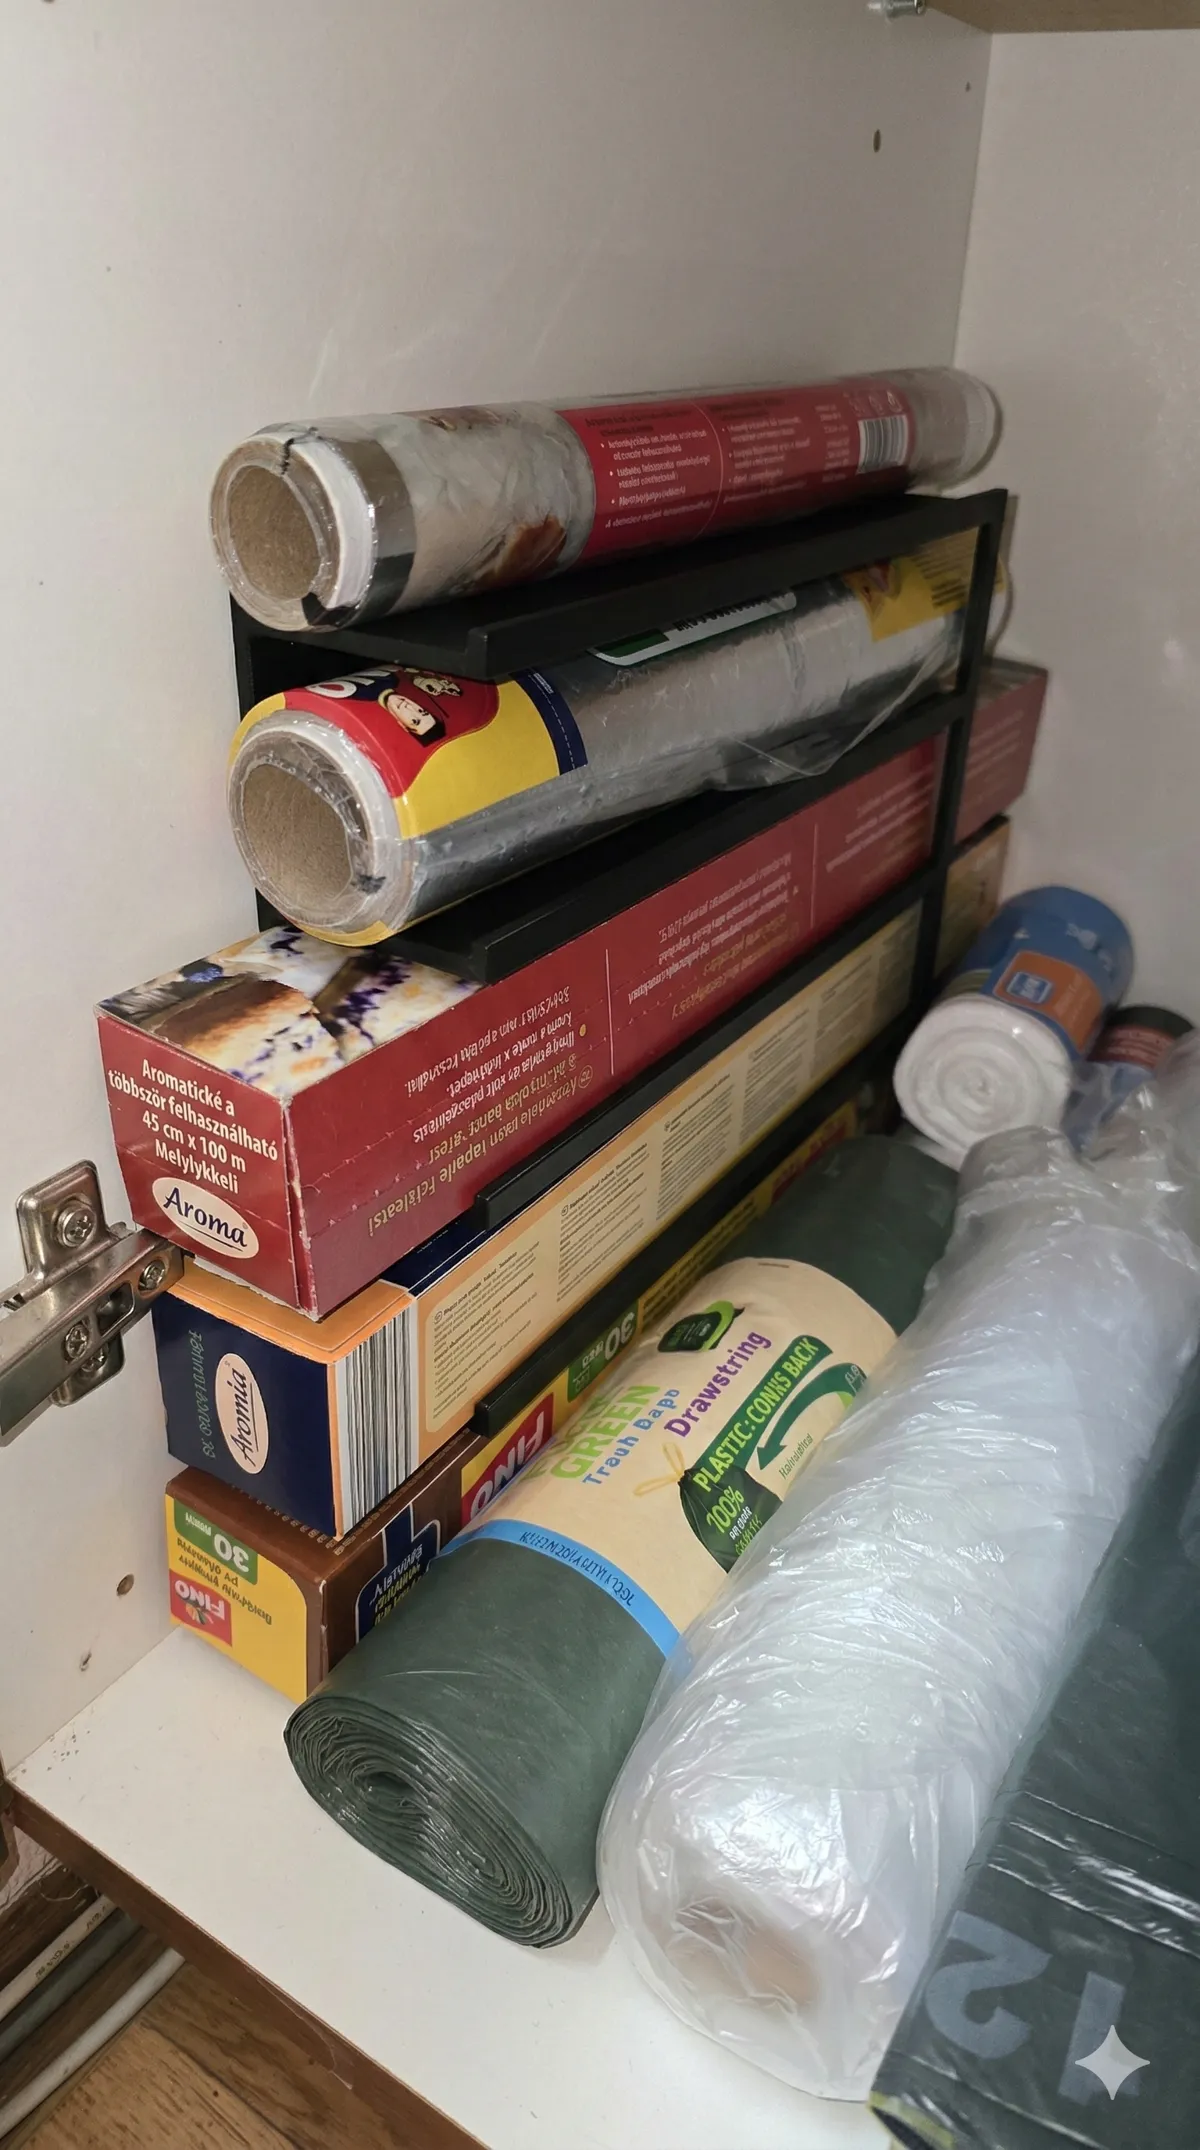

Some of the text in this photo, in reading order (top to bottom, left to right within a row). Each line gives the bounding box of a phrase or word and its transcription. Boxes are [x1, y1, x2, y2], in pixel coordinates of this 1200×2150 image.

[108, 1069, 278, 1161] többször felhasználható
[142, 1059, 235, 1116] Aromatické a
[142, 1110, 246, 1172] 45 cm x 100 m
[163, 1187, 248, 1247] Aroma
[664, 1332, 772, 1437] Drawstring
[782, 1337, 819, 1377] BACK
[230, 1367, 256, 1468] Aromia
[550, 1385, 661, 1479] GREEN
[470, 1411, 545, 1521] FINO
[213, 1533, 250, 1574] 30
[174, 1579, 225, 1621] FINO
